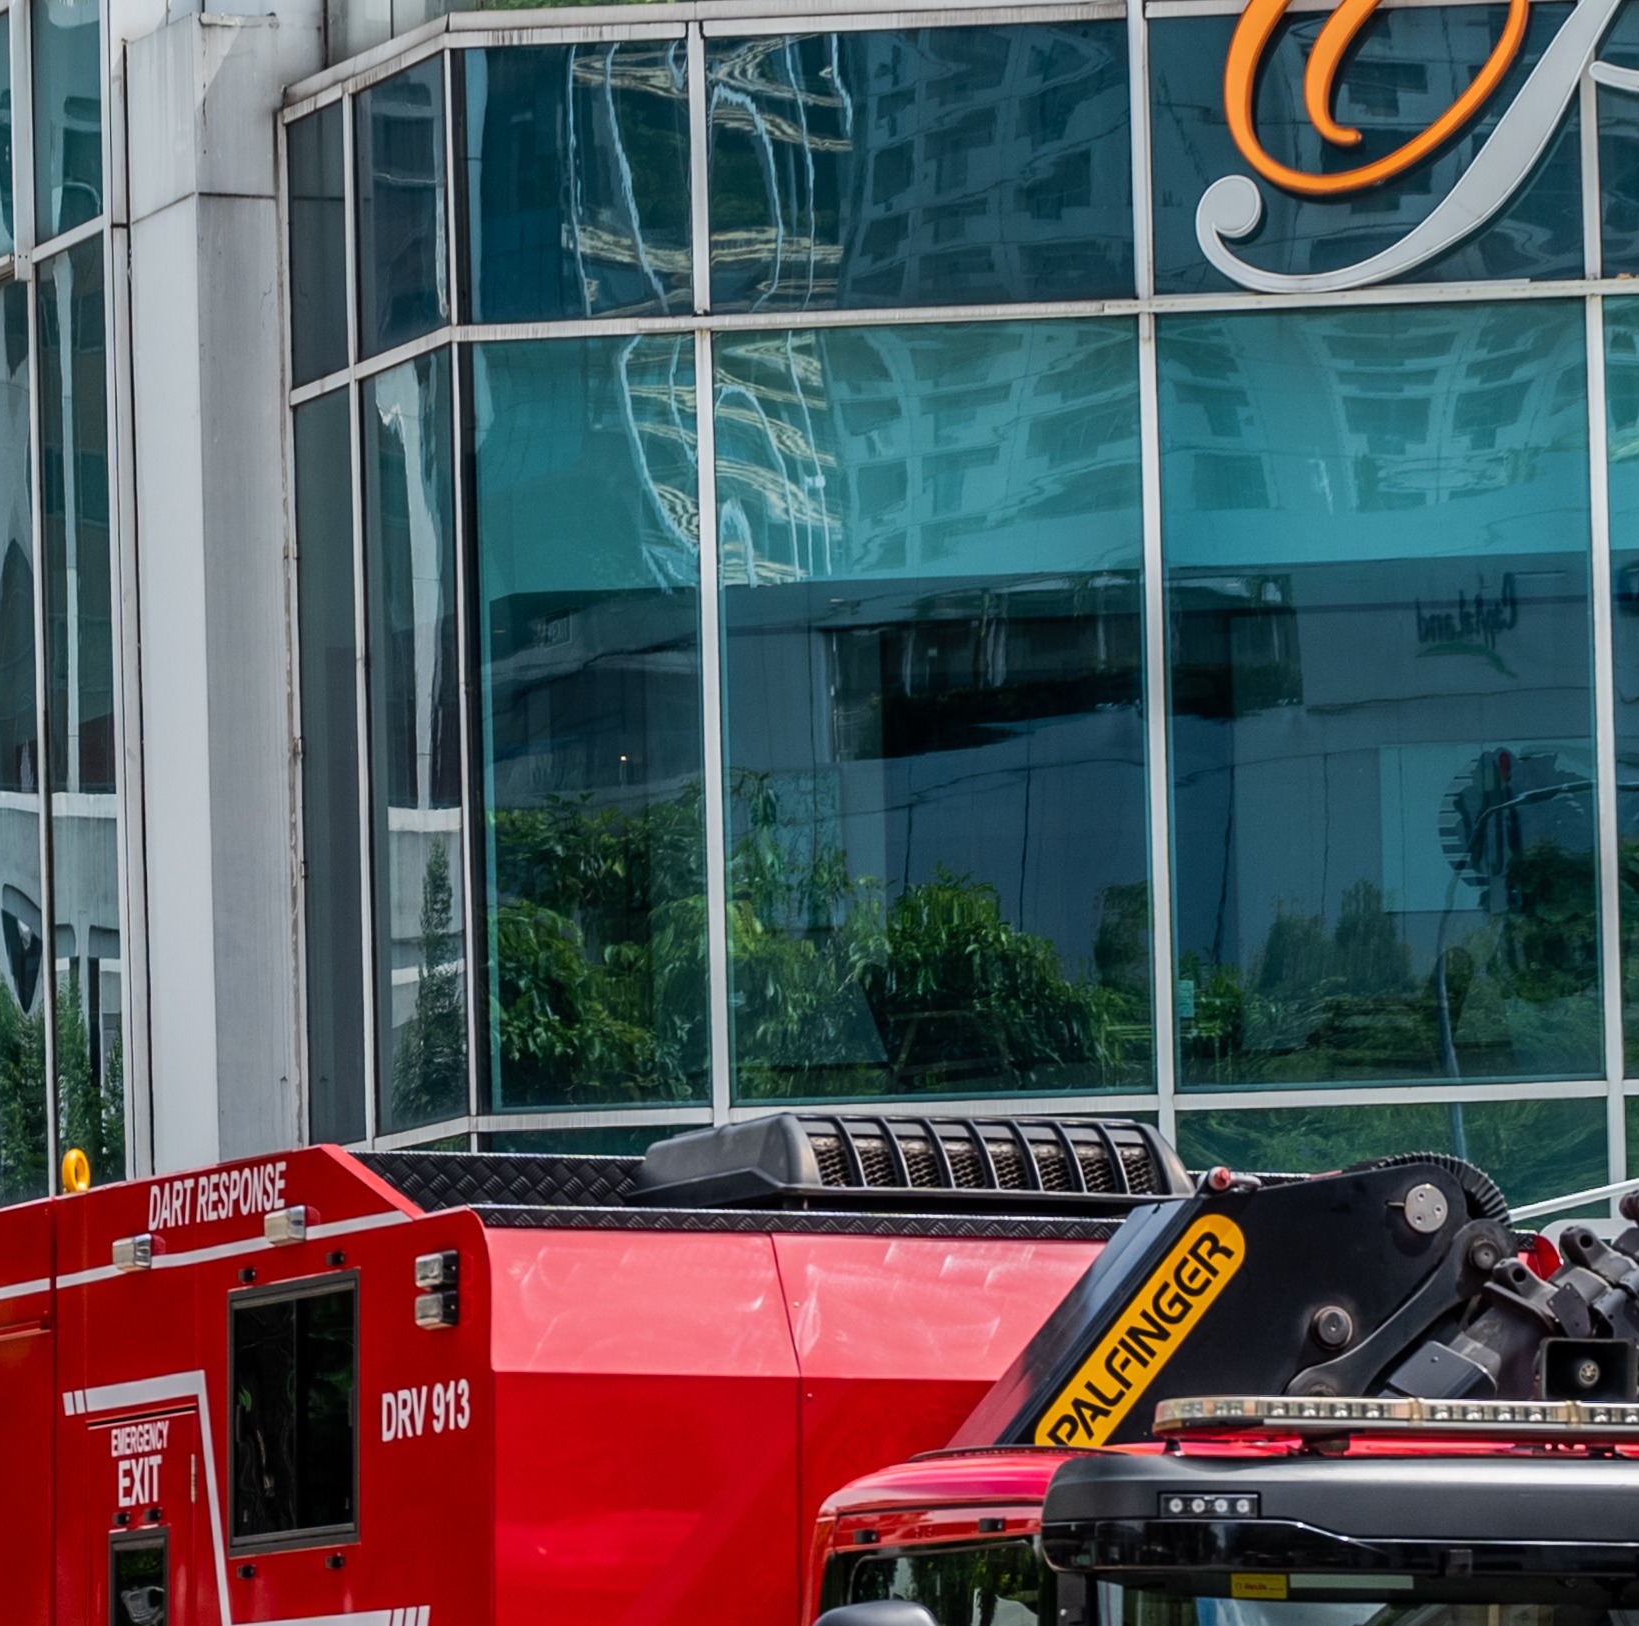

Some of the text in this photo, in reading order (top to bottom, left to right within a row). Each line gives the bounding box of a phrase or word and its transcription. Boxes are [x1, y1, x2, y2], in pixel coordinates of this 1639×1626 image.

[148, 1161, 287, 1231] DART RESPONSE
[1046, 1231, 1235, 1446] PALFINGER
[111, 1420, 169, 1457] EMERGENCY
[381, 1378, 471, 1442] DRV 913
[118, 1454, 163, 1508] EXIT
